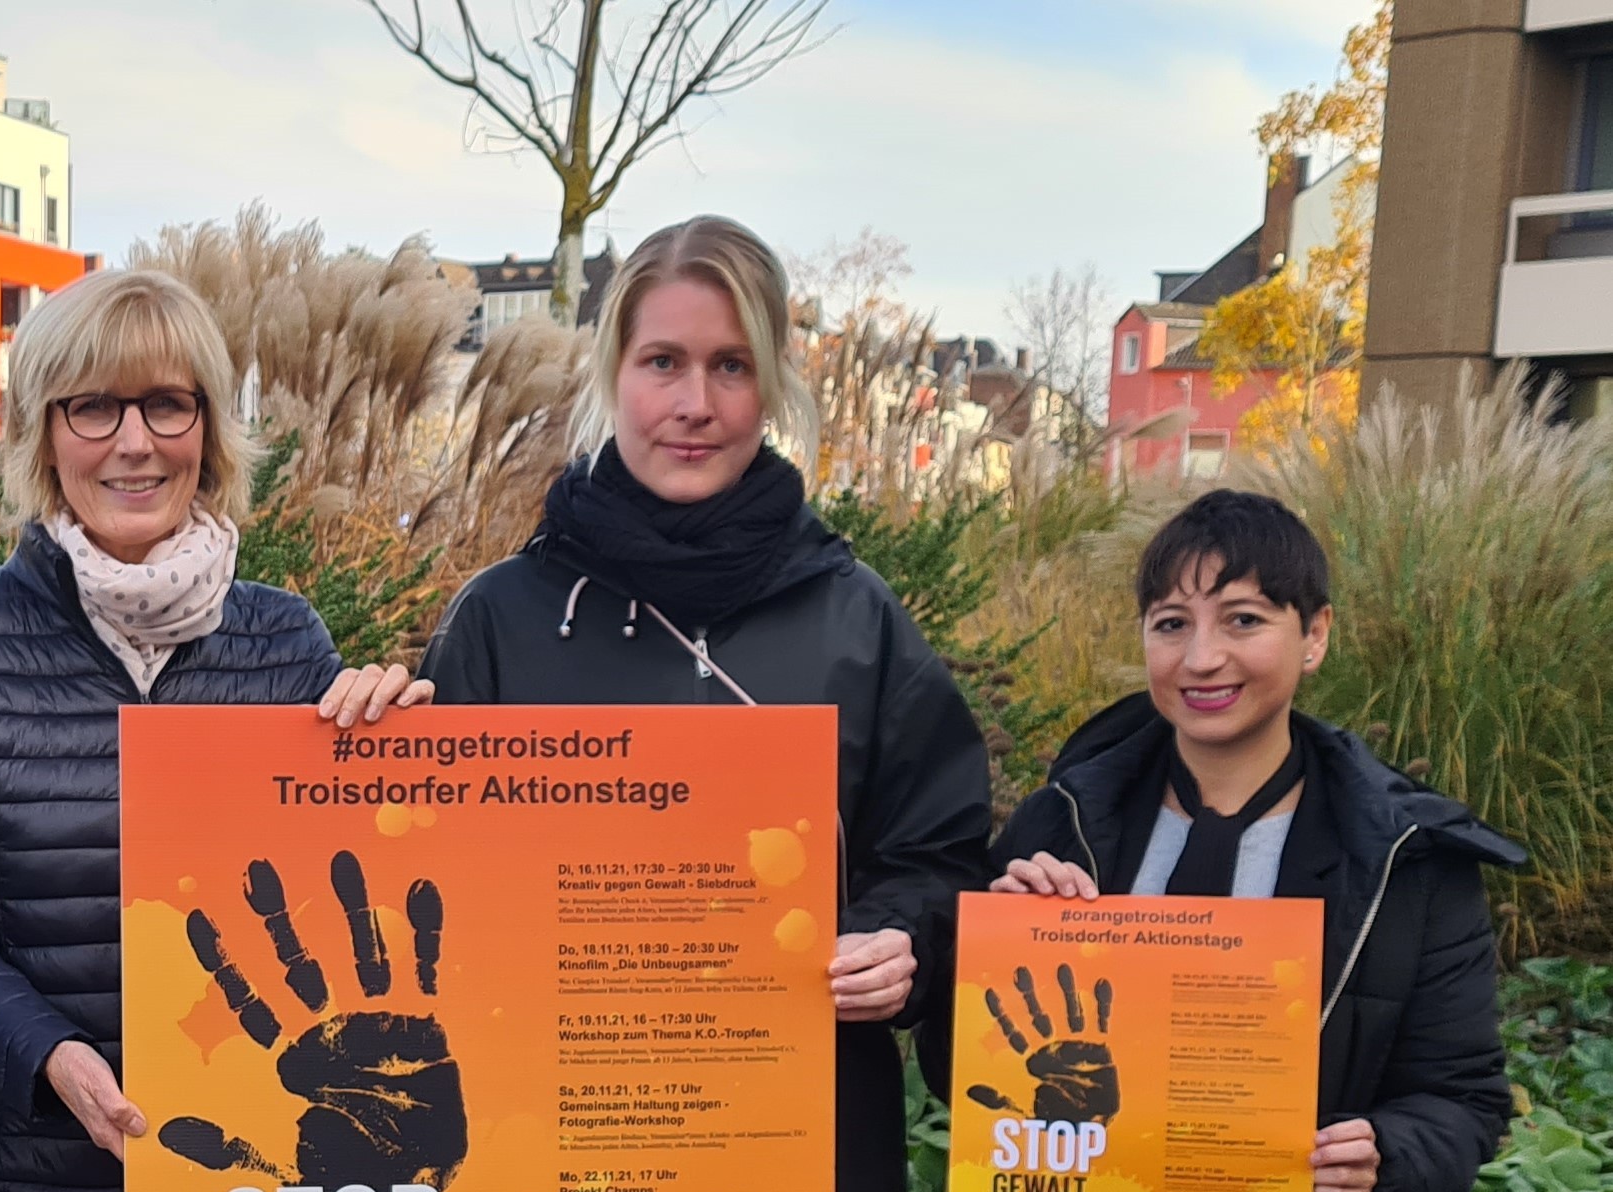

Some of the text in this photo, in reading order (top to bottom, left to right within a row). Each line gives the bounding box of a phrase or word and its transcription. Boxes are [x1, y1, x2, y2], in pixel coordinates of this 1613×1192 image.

[332, 728, 632, 766] #orangetroisdorf
[273, 776, 689, 810] Troisdorfer Aktionstage
[559, 864, 574, 876] Di,
[634, 863, 665, 874] 17:30
[679, 863, 710, 873] 20:30
[714, 863, 735, 873] Uhr
[559, 880, 601, 890] Kreativ
[605, 882, 641, 892] gegen
[645, 879, 685, 889] Gewalt
[697, 878, 756, 889] Siebdruck
[1061, 909, 1213, 926] #orangetroisdorf
[1031, 928, 1242, 950] Troisdorfer Aktionstage
[559, 944, 579, 956] Do,
[583, 944, 633, 956] 18.11.21,
[638, 943, 669, 954] 18:30
[683, 943, 714, 953] 20:30
[719, 943, 739, 953] Uhr
[559, 959, 608, 970] Kinofilm
[559, 1015, 574, 1027] Fr,
[633, 1014, 646, 1024] 16
[661, 1013, 692, 1024] 17:30
[695, 1013, 716, 1023] Uhr
[559, 1028, 769, 1042] Workshop zum Thema K.O.-Tropfen
[559, 1086, 577, 1098] Sa,
[581, 1085, 632, 1097] 20.11.21,
[637, 1085, 649, 1095] 12
[665, 1084, 677, 1094] 17
[681, 1084, 702, 1094] Uhr
[559, 1101, 630, 1111] Gemeinsam
[633, 1100, 679, 1112] Haltung
[683, 1099, 721, 1111] zeigen
[560, 1115, 685, 1129] Fotografie-Workshop
[993, 1119, 1106, 1171] STOP
[560, 1170, 677, 1184] Mo, 22.11.21, 17 Uhr
